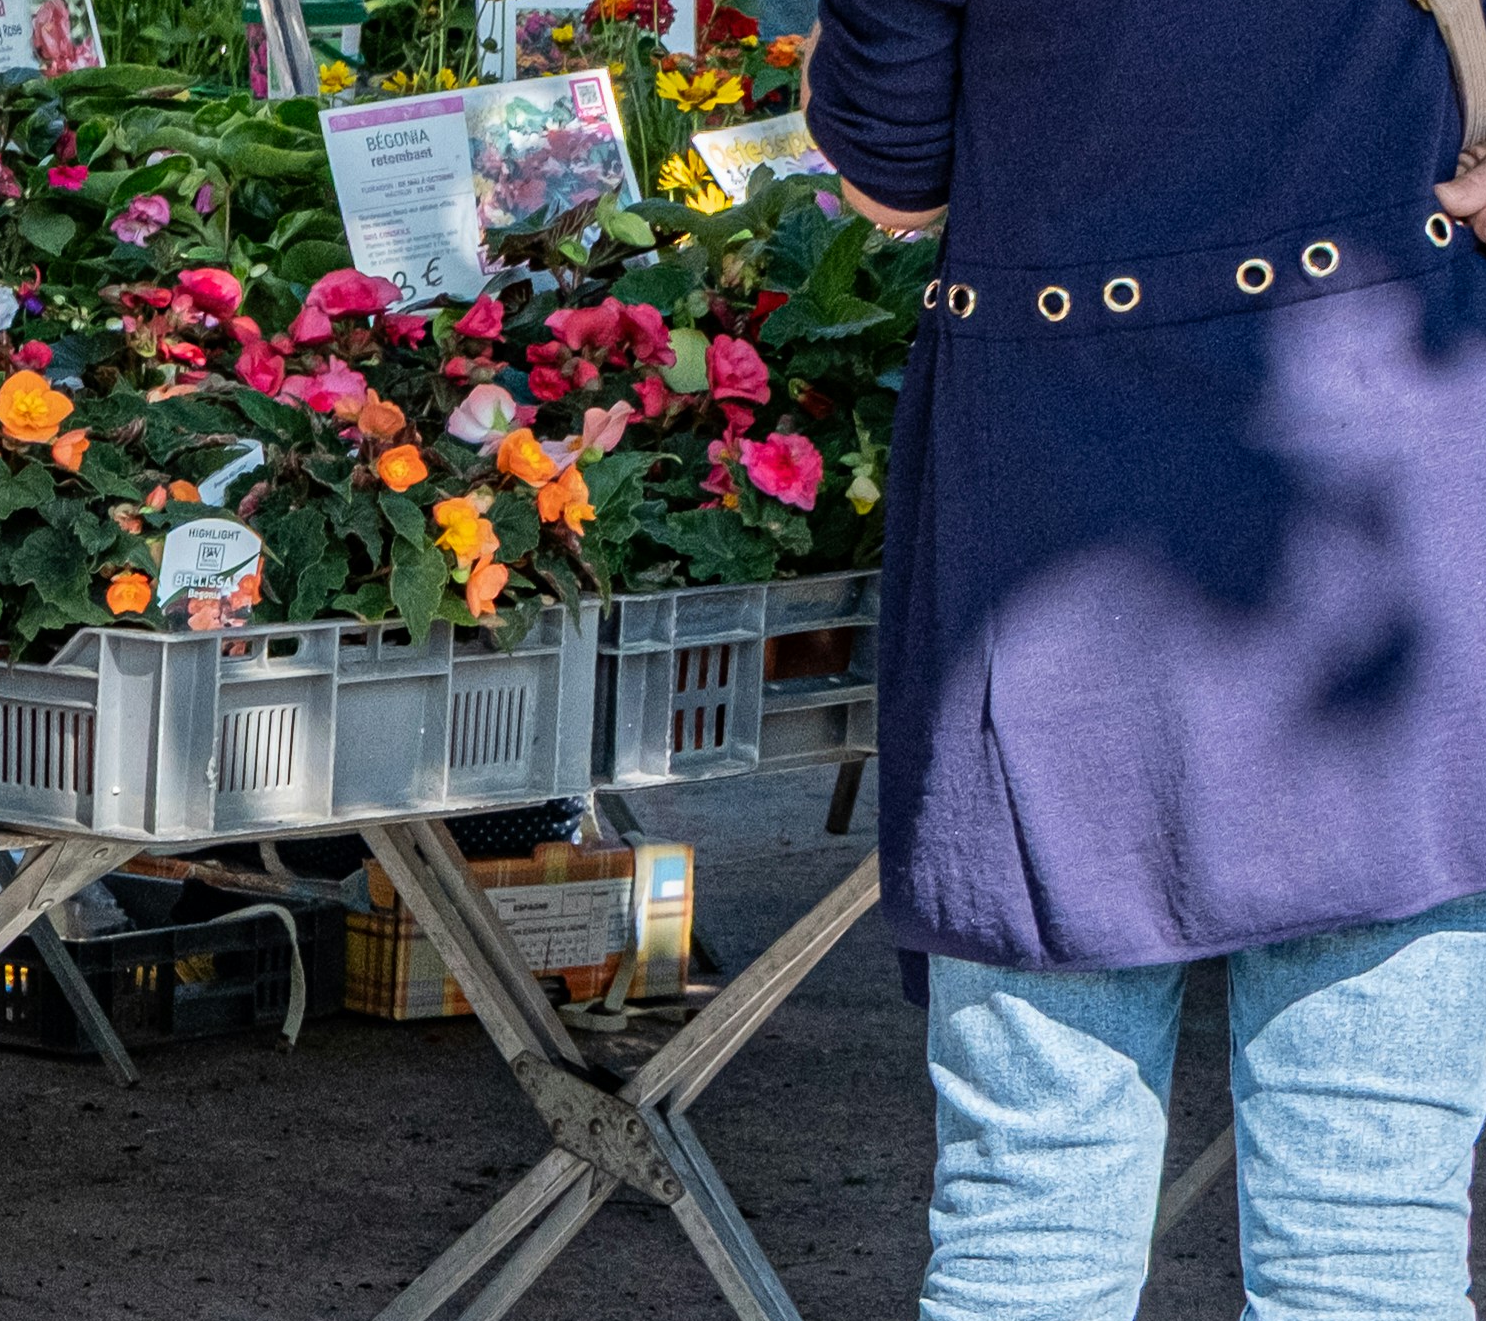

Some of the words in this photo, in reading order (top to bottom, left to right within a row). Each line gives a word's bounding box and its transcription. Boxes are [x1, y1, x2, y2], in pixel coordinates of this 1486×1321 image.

[365, 127, 431, 153] BÉGONIA
[188, 528, 242, 542] HIGHLIGHT
[174, 573, 232, 589] BELLISSA
